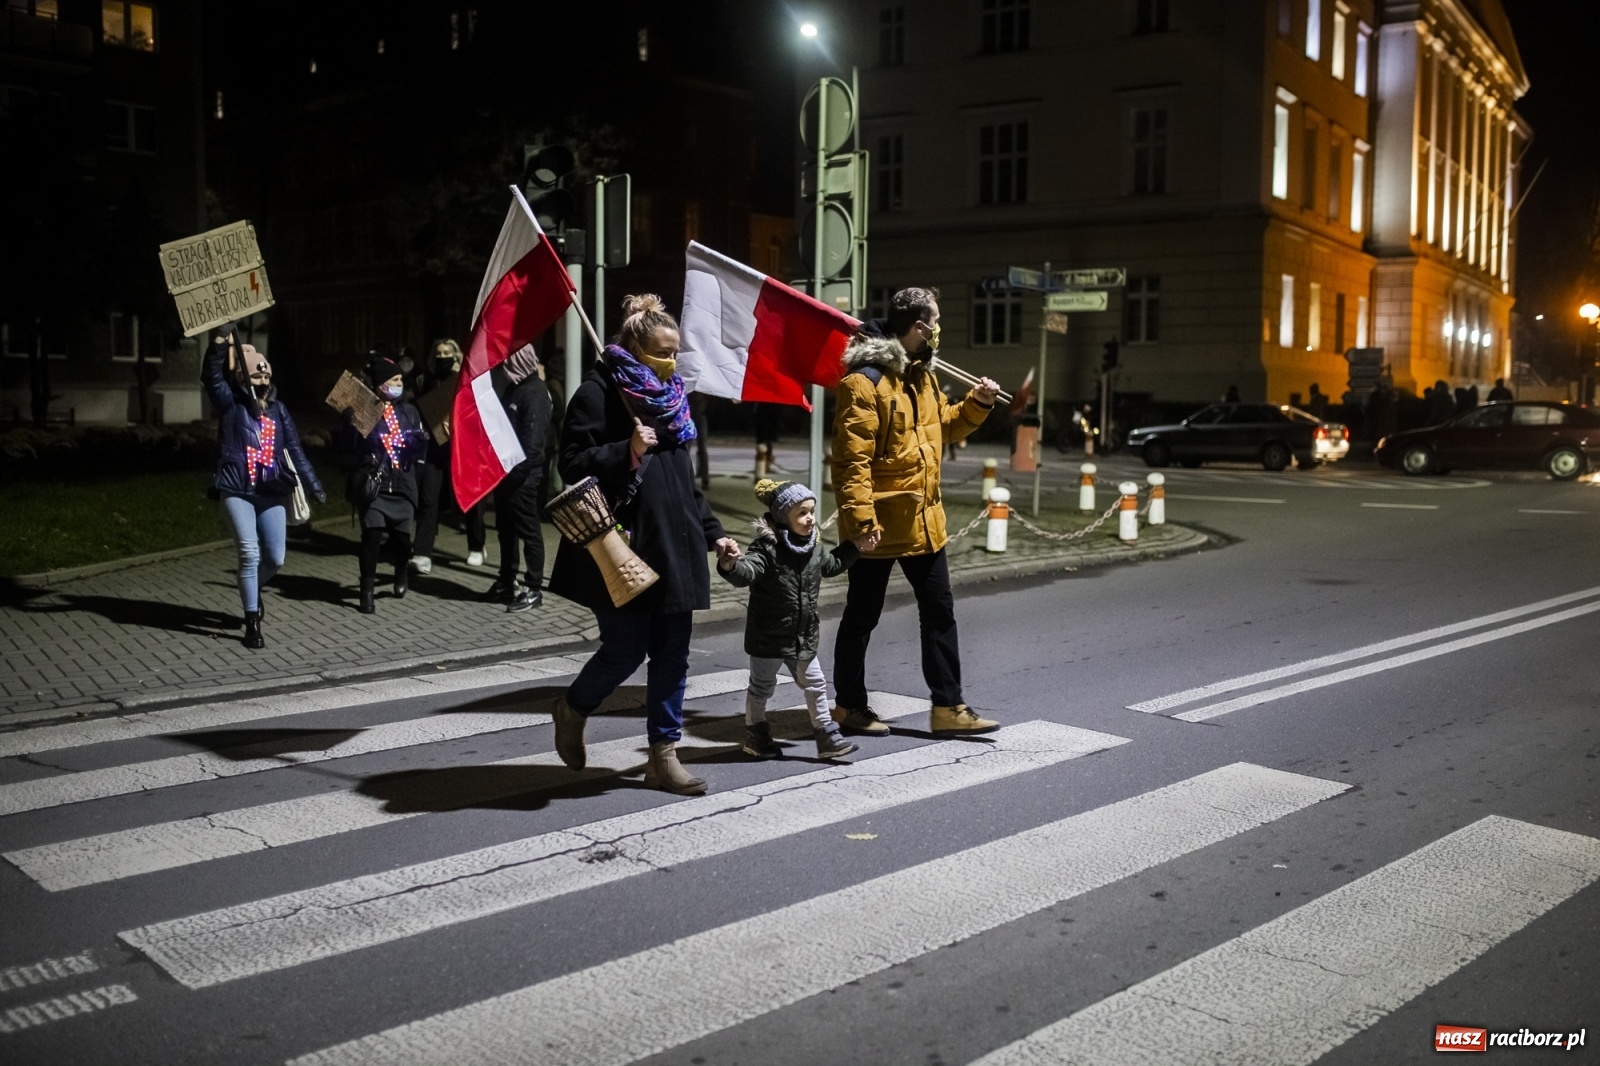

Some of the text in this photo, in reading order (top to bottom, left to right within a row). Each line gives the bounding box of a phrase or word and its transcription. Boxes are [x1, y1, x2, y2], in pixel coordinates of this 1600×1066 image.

[168, 239, 211, 268] STRACH
[170, 248, 250, 287] KACZORA LEPSZY
[212, 280, 228, 295] OD
[181, 287, 250, 331] WIBRATORA
